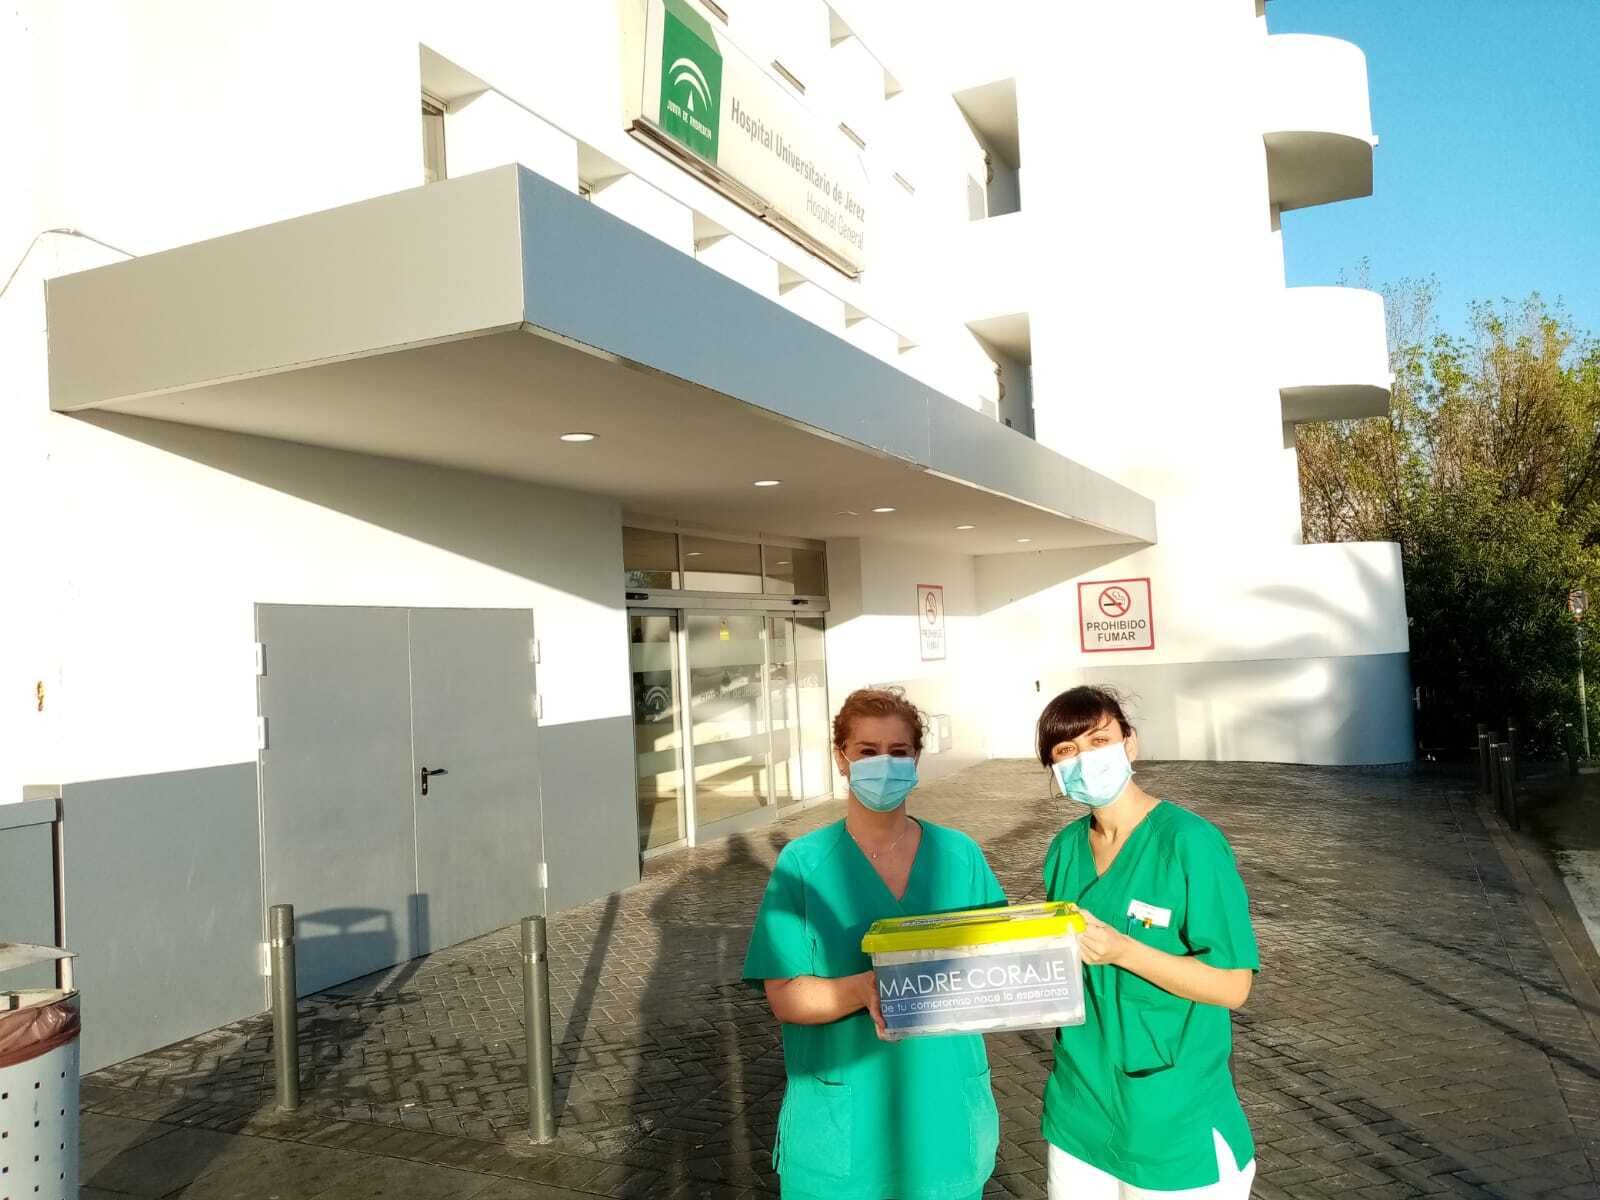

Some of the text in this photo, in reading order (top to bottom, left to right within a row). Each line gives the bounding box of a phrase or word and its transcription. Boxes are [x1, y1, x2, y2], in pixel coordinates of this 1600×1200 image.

[731, 96, 865, 223] Hospital Universitario de Jerez
[806, 191, 865, 250] Hospital General
[1086, 619, 1146, 631] PROHIBIDO
[1097, 631, 1136, 642] FUMAR
[879, 960, 1067, 998] MADRE CORAJE
[881, 987, 1069, 1013] De tu compromiso nace la esperanza
